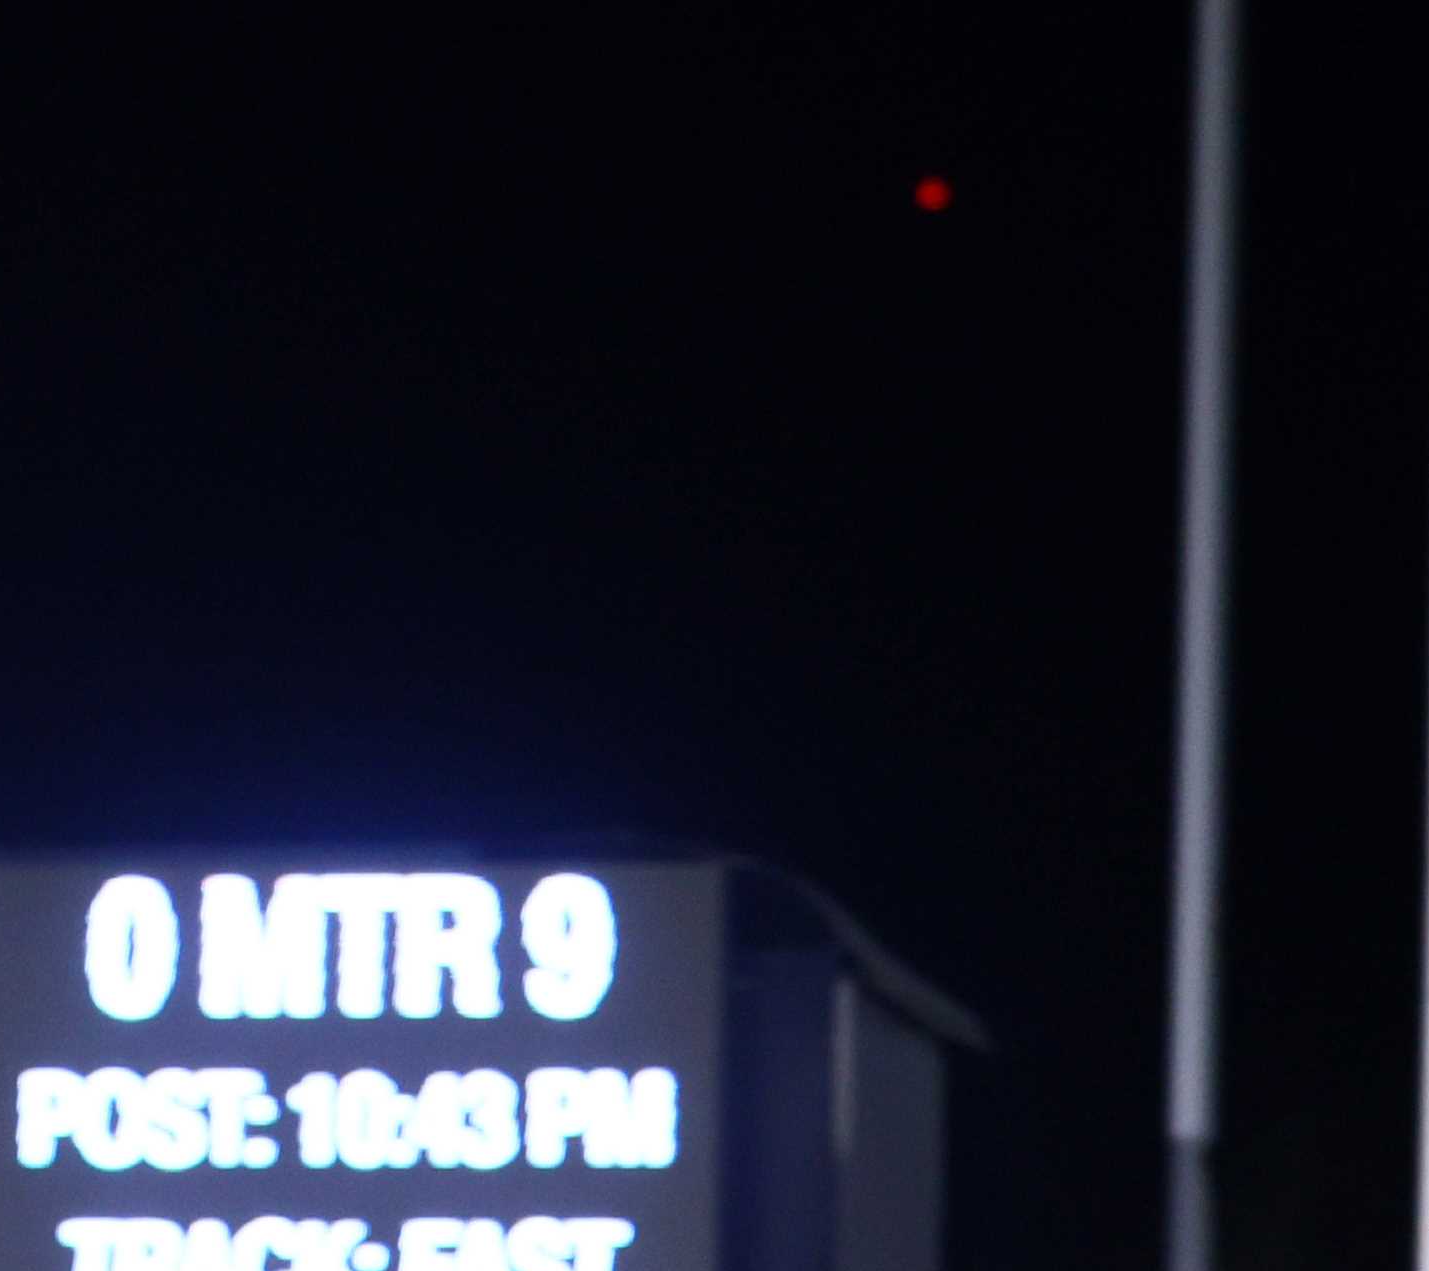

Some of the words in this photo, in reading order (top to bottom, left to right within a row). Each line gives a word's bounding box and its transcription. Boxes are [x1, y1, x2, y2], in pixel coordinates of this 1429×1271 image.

[197, 870, 503, 1021] MTR
[520, 872, 620, 1022] 9
[15, 1064, 280, 1171] POST:
[284, 1067, 520, 1171] 10:43
[523, 1065, 679, 1169] PM
